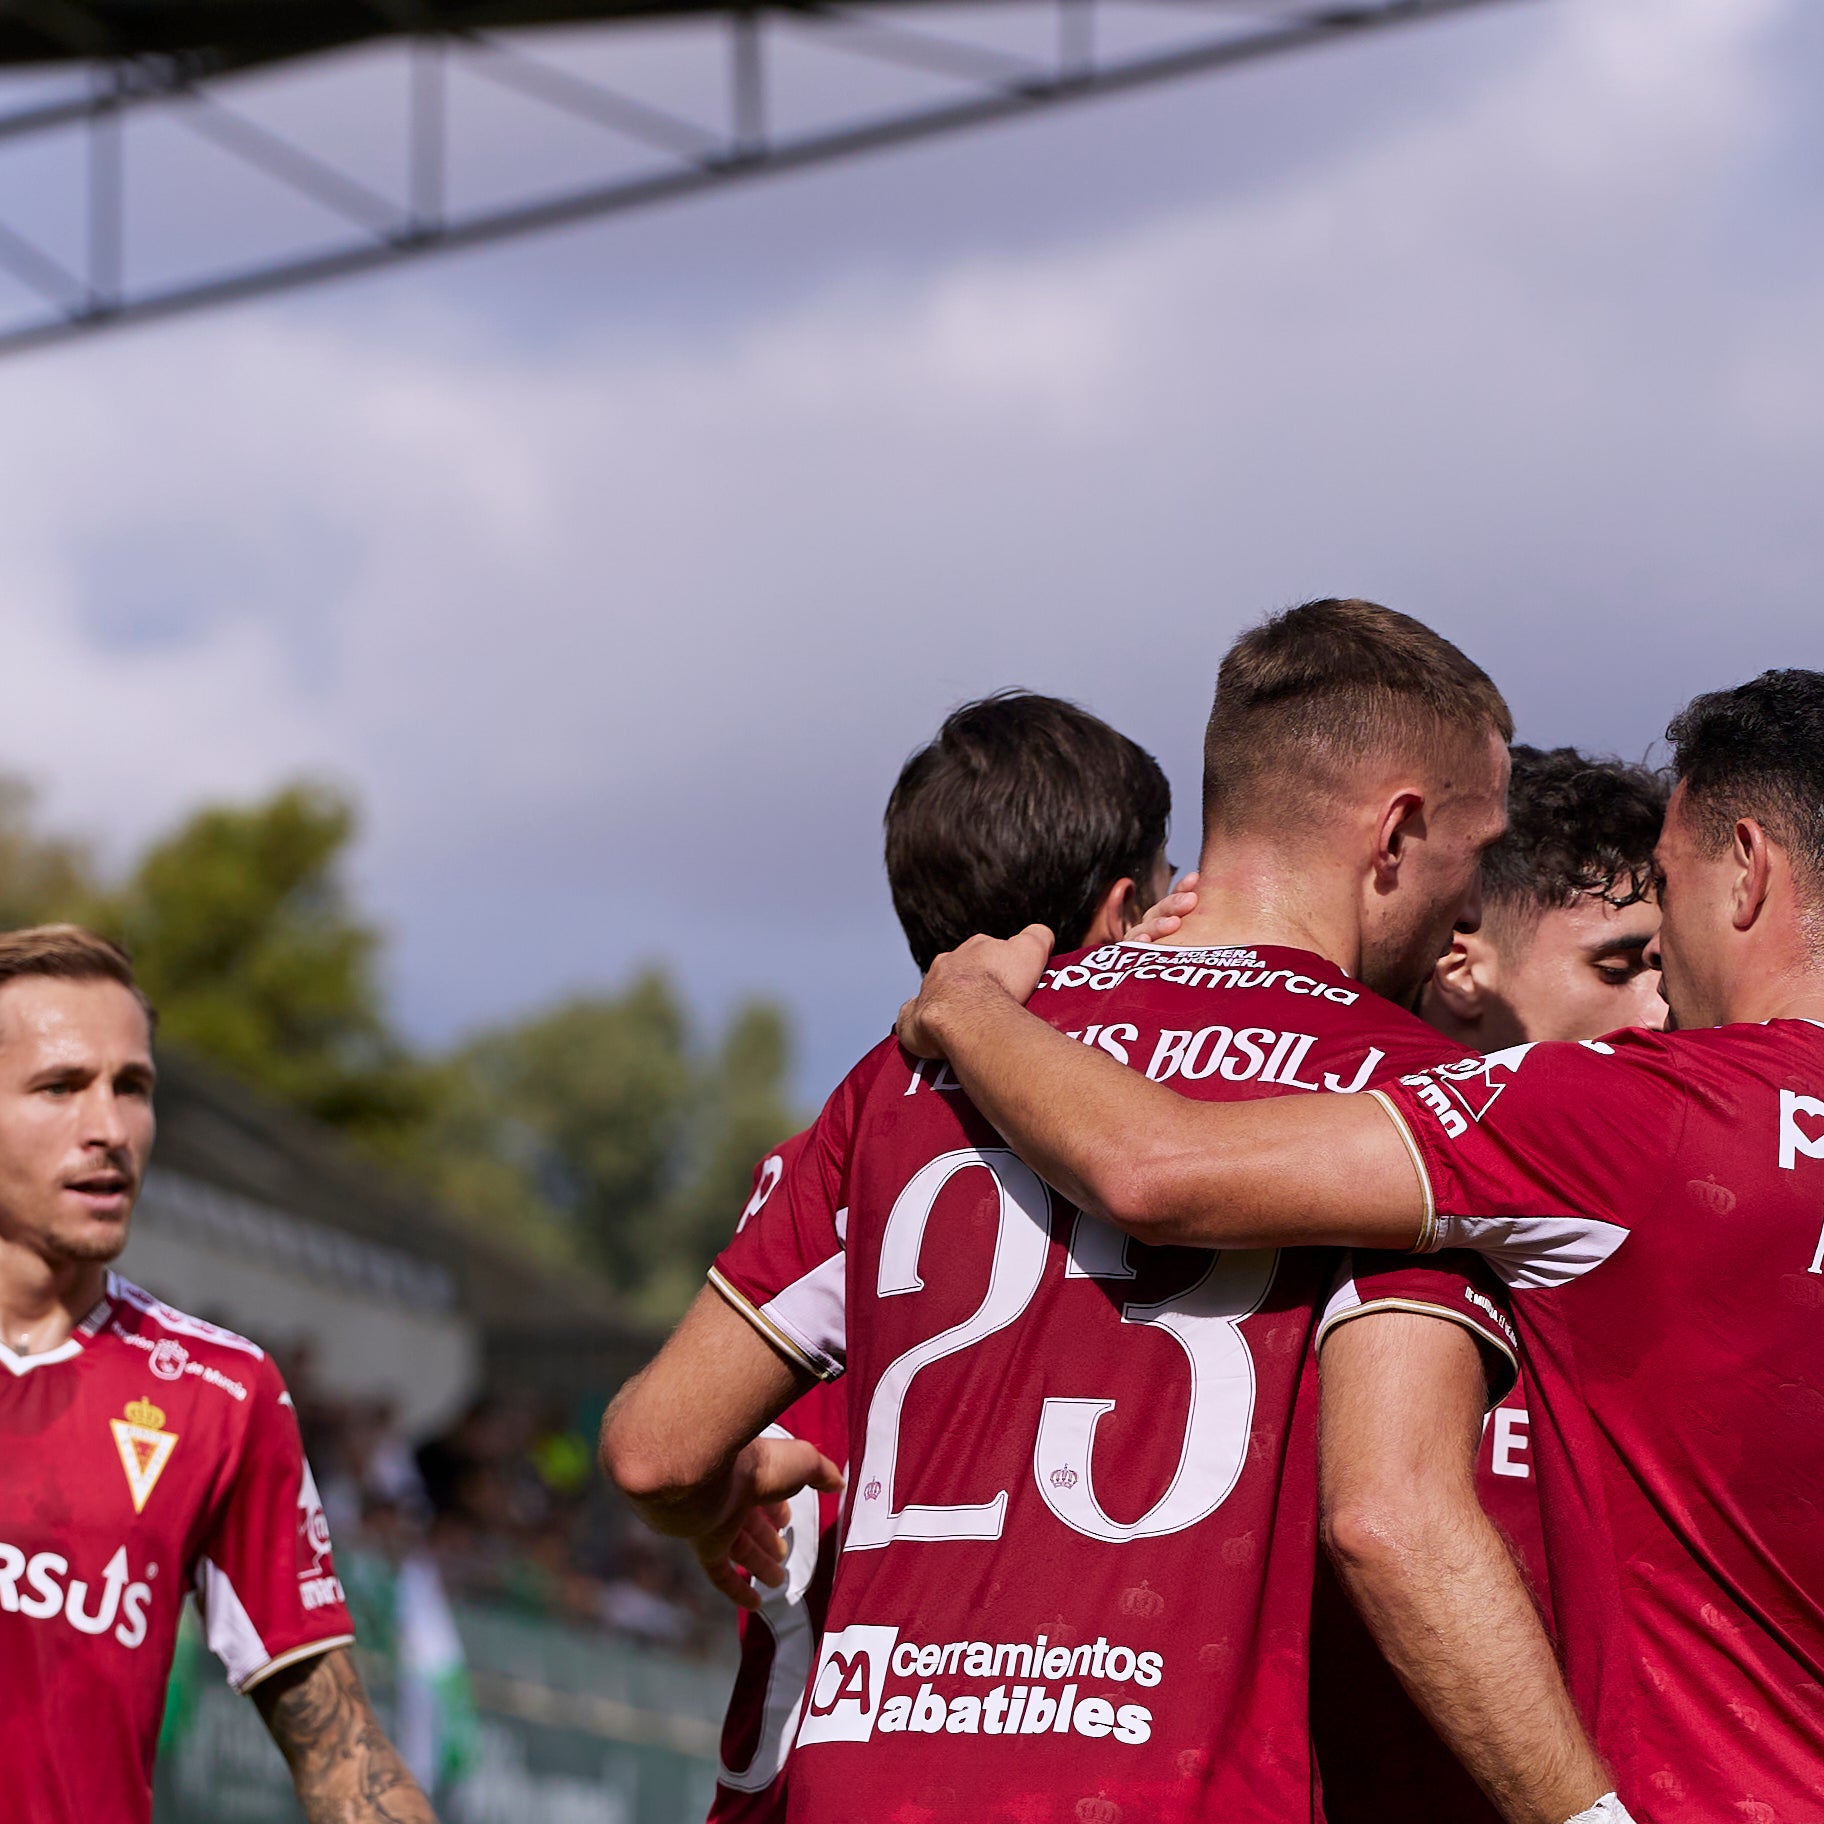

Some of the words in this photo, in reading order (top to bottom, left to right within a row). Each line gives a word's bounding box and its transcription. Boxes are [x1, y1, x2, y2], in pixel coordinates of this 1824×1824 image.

[842, 1147, 1282, 1553] 23
[891, 1634, 1165, 1688] cerramientos
[877, 1683, 1154, 1745] abatibles
